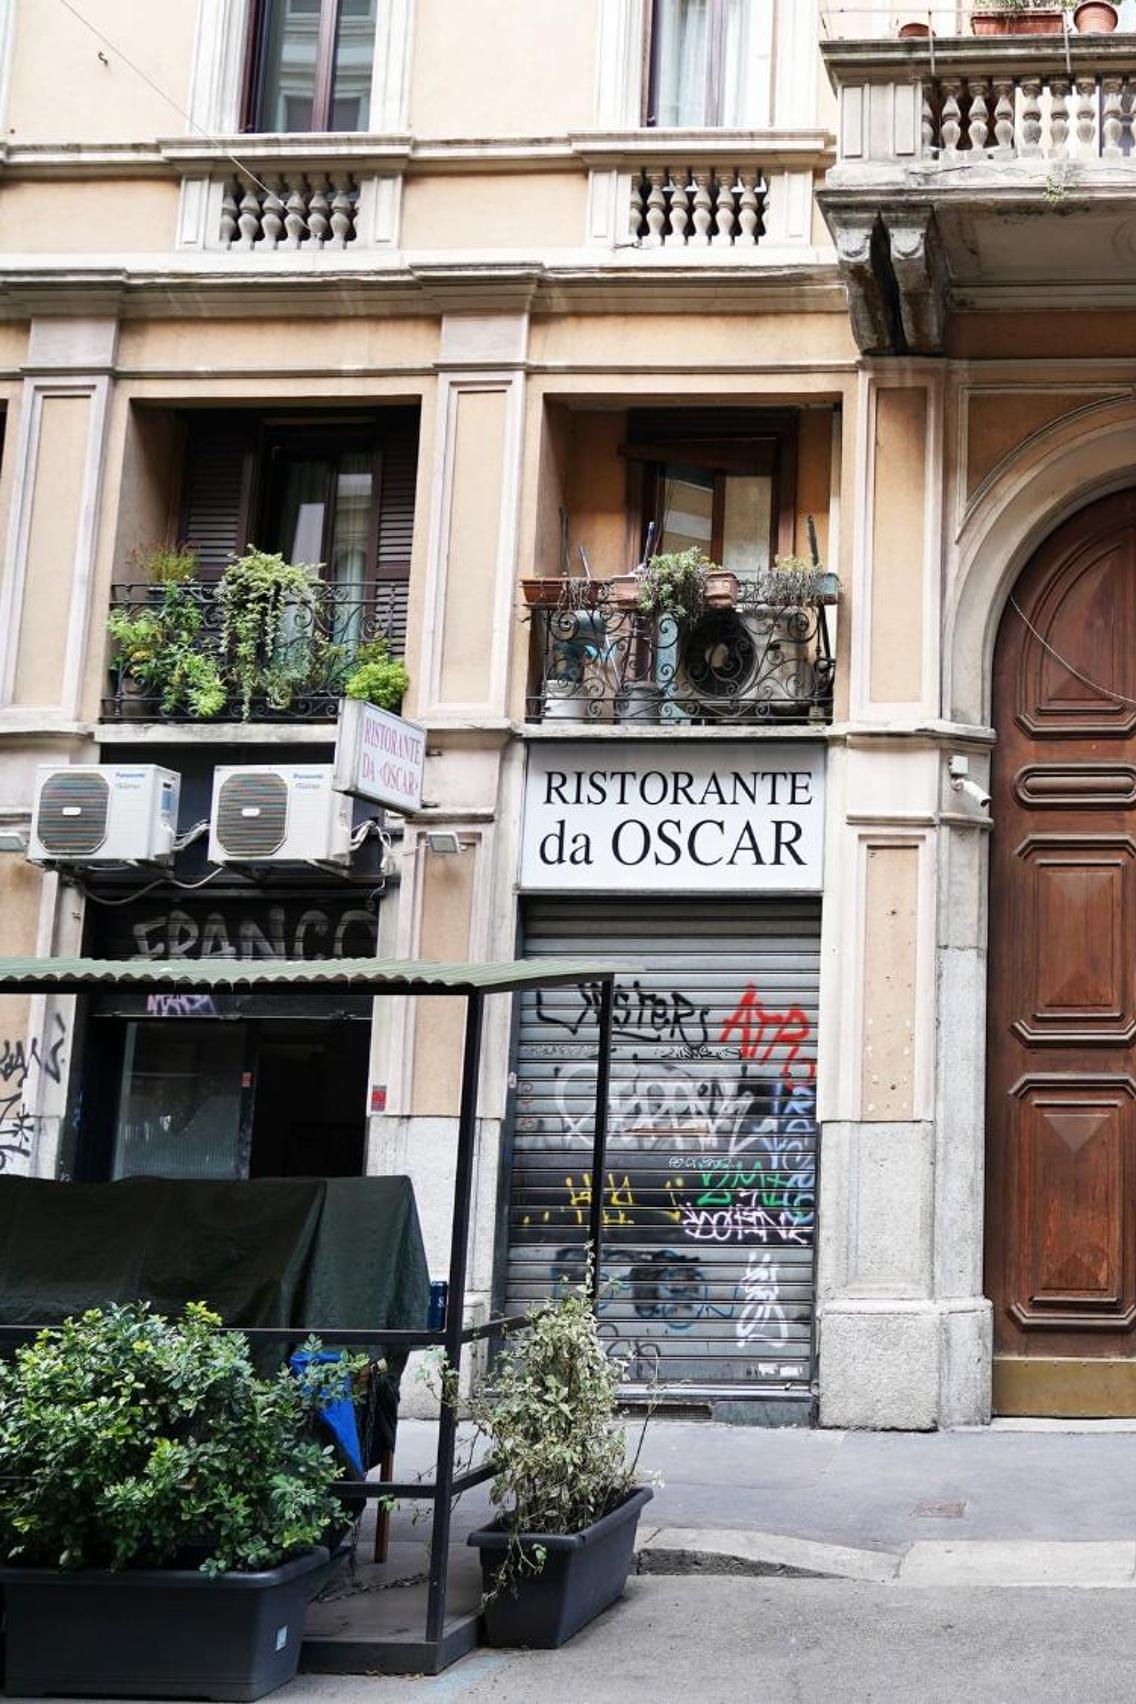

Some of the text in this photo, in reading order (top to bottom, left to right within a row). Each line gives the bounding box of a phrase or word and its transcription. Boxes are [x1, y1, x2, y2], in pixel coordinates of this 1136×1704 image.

[364, 718, 422, 765] RISTORANTE
[363, 753, 375, 782] DA
[542, 770, 813, 806] RISTORANTE
[538, 818, 808, 867] da OSCAR
